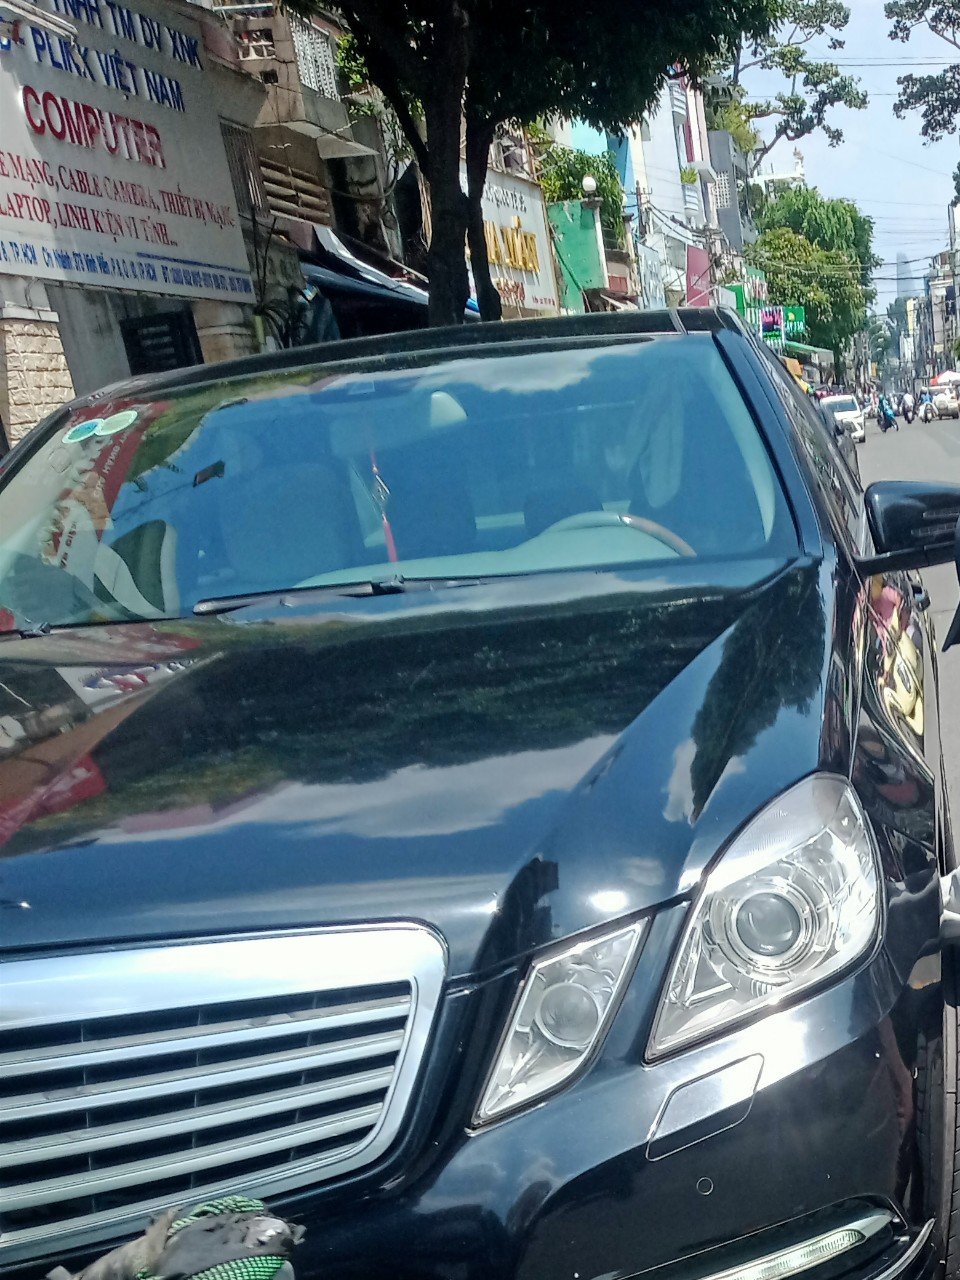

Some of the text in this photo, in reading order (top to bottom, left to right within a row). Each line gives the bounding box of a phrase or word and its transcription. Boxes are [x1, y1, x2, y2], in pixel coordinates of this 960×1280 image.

[106, 1, 137, 42] TM
[139, 13, 162, 52] DV
[166, 28, 204, 71] XNK
[143, 67, 186, 112] NAM
[22, 85, 166, 169] COMPUTER
[55, 202, 91, 231] LINH
